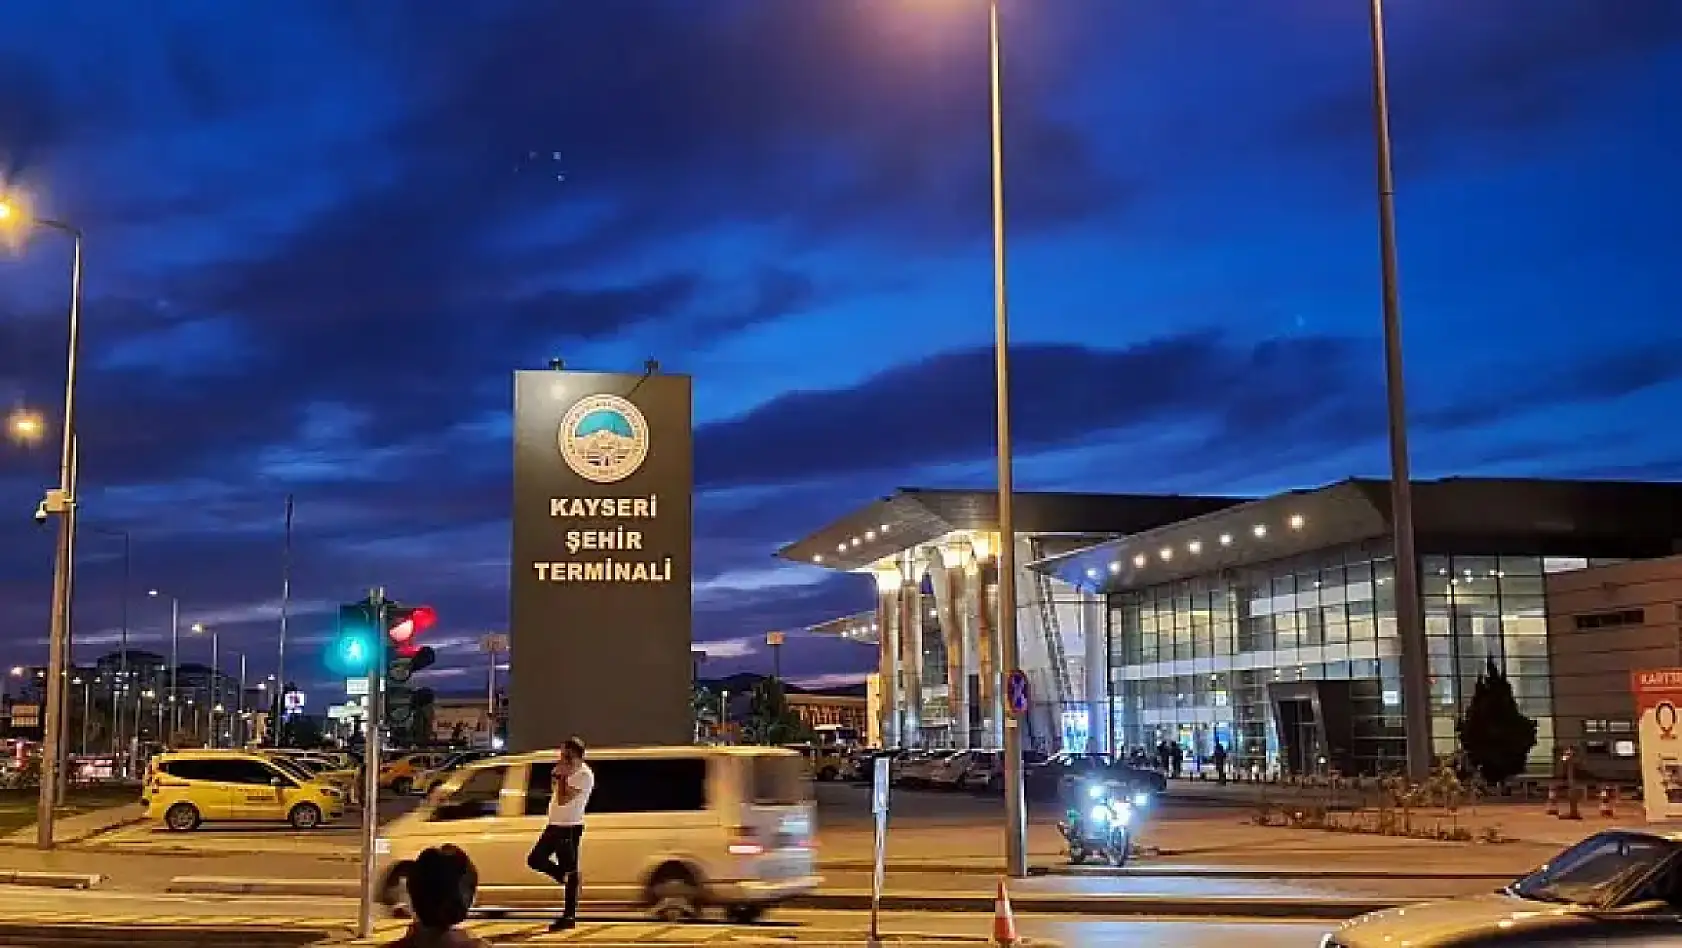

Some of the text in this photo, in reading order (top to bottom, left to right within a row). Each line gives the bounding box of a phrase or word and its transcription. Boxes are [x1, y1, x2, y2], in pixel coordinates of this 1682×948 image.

[550, 494, 657, 517] KAYSERİ
[565, 525, 642, 554] ŞEHİR
[534, 557, 671, 581] TERMİNALİ
